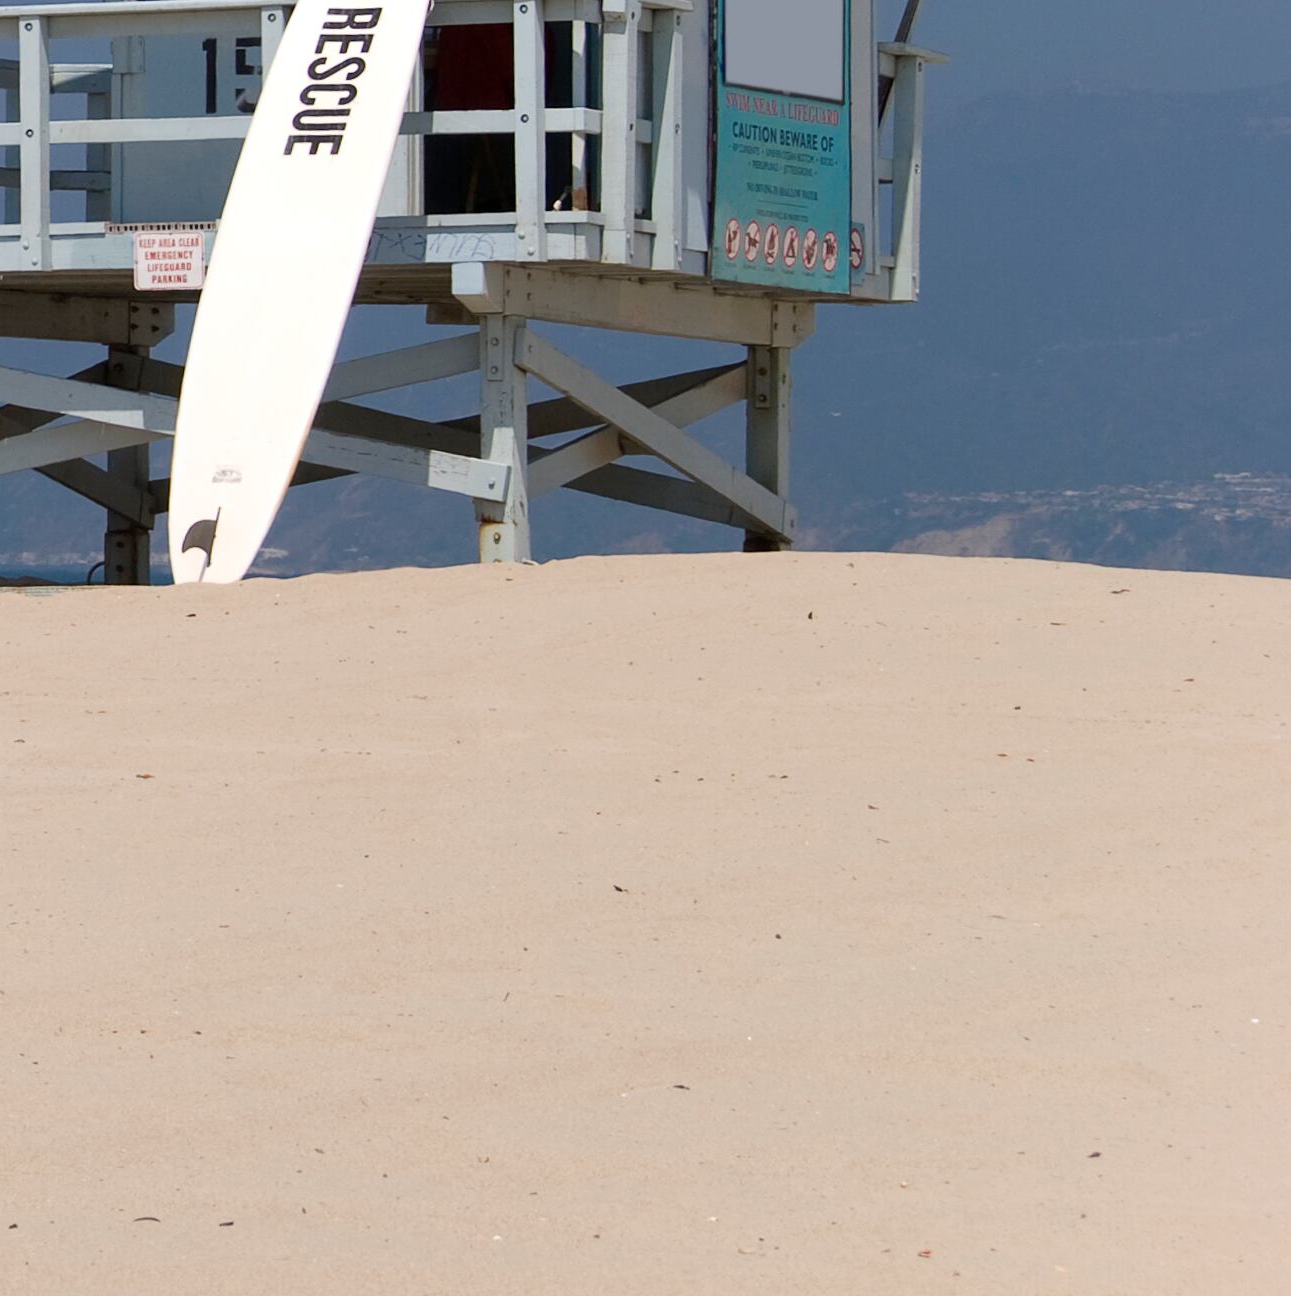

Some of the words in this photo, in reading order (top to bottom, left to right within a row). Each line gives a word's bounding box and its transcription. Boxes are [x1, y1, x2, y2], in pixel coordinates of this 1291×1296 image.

[201, 36, 263, 115] 15
[283, 7, 383, 156] RESCUE
[788, 102, 839, 127] LIFEGUARD
[732, 121, 777, 144] CAUTION
[780, 129, 818, 151] BEWARE
[820, 135, 834, 153] OF
[139, 239, 155, 248] KEEP
[159, 238, 175, 247] AREA
[179, 238, 199, 247] CLEAR
[145, 251, 193, 260] EMERGENCY
[148, 263, 192, 272] LIFEGUARD
[152, 274, 187, 283] PARKING
